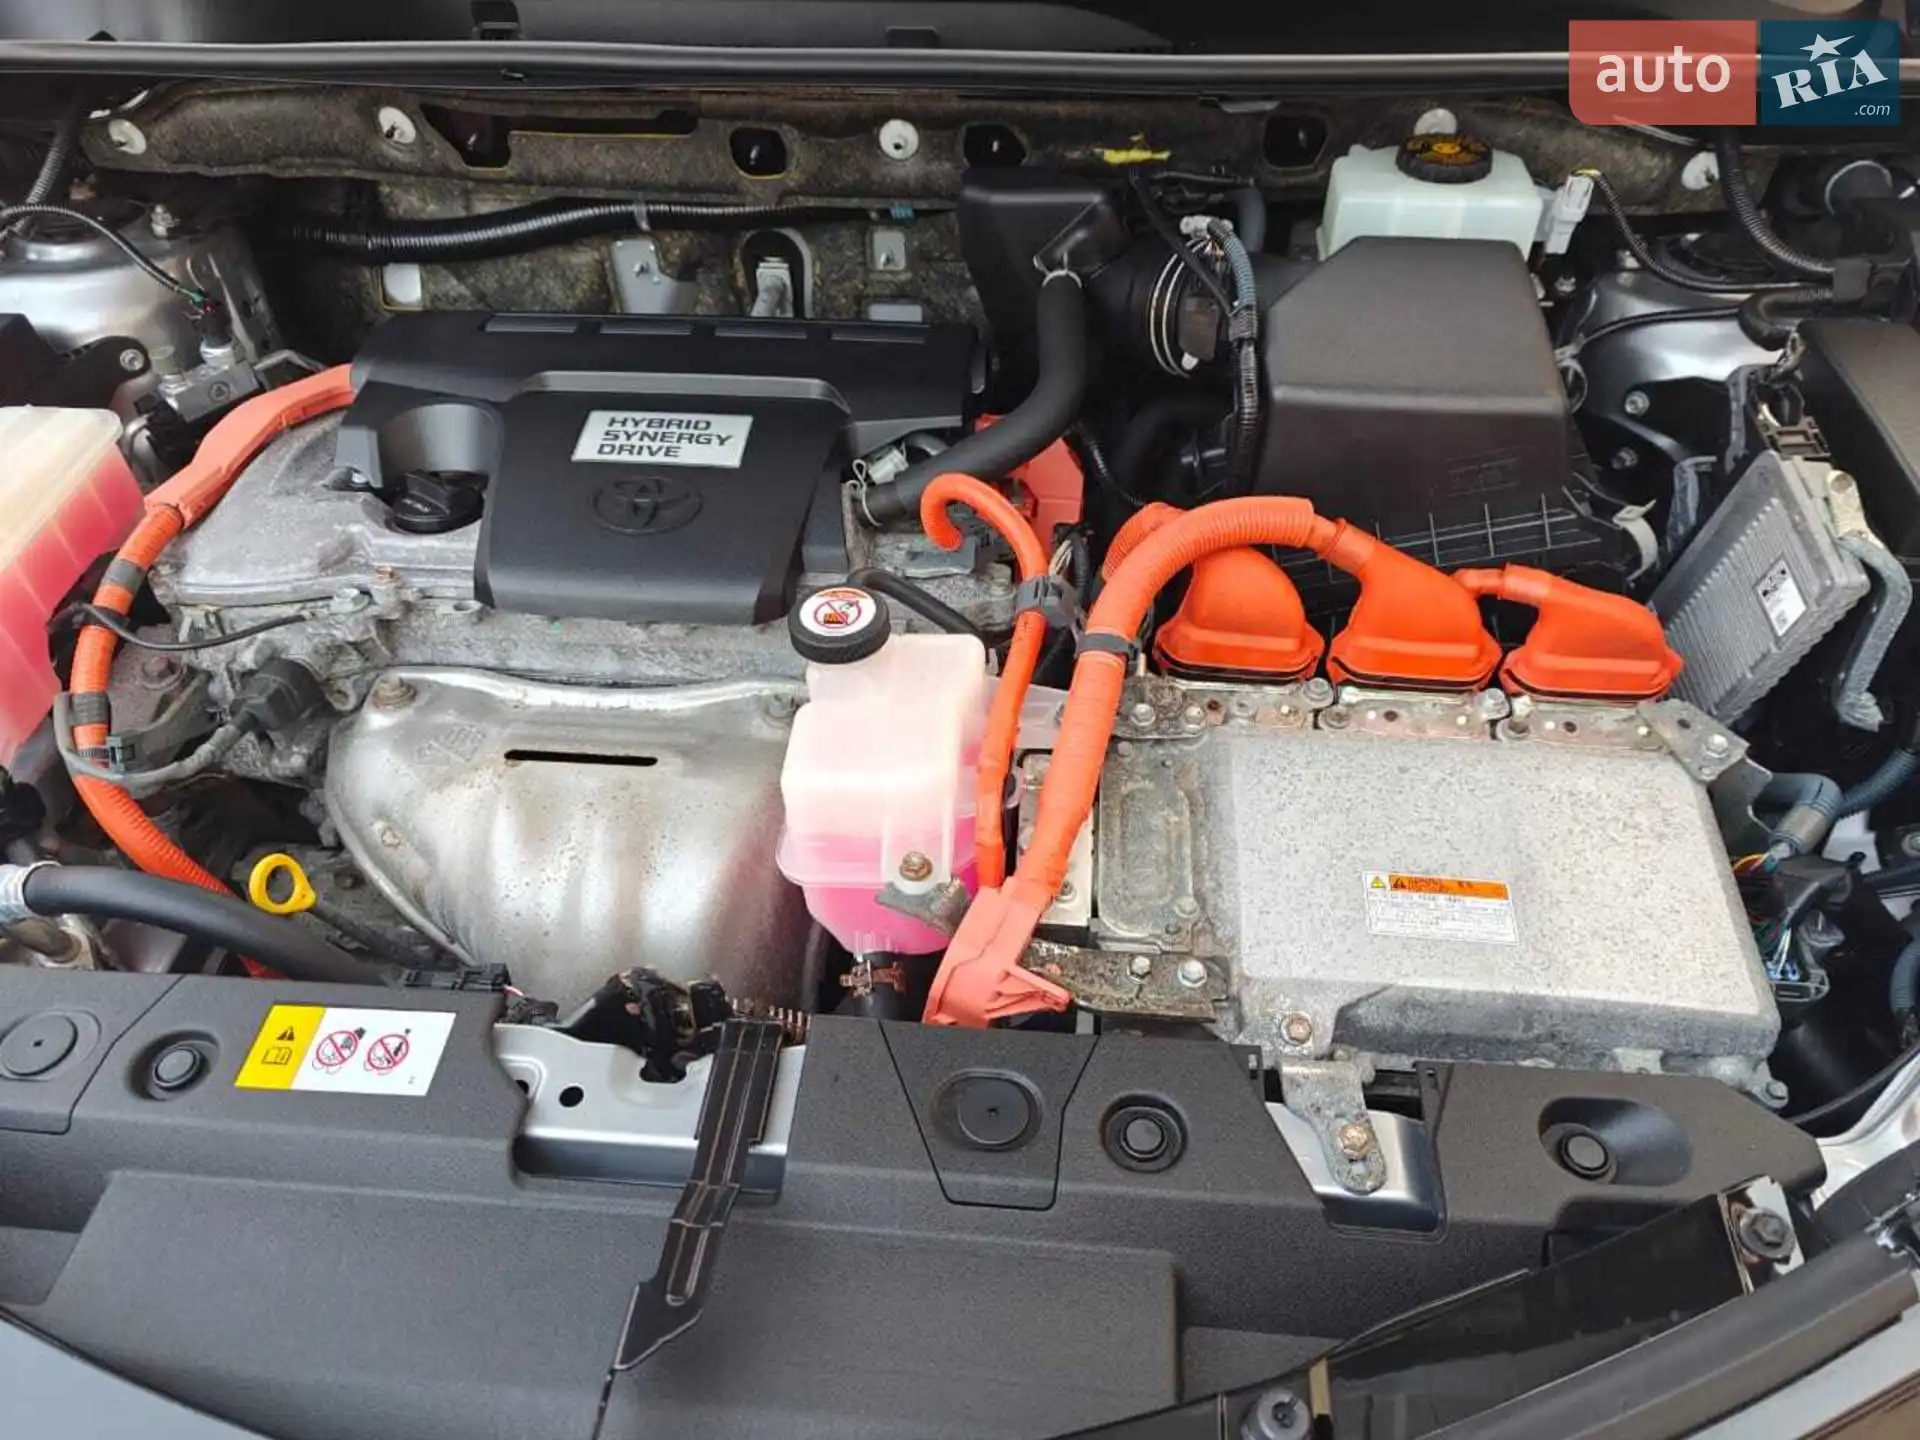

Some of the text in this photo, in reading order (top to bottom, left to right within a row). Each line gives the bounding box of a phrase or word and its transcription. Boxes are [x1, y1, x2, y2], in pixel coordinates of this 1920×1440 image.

[608, 416, 712, 431] HYBRID
[602, 430, 733, 446] SYNERGY
[597, 443, 682, 458] DRIVE
